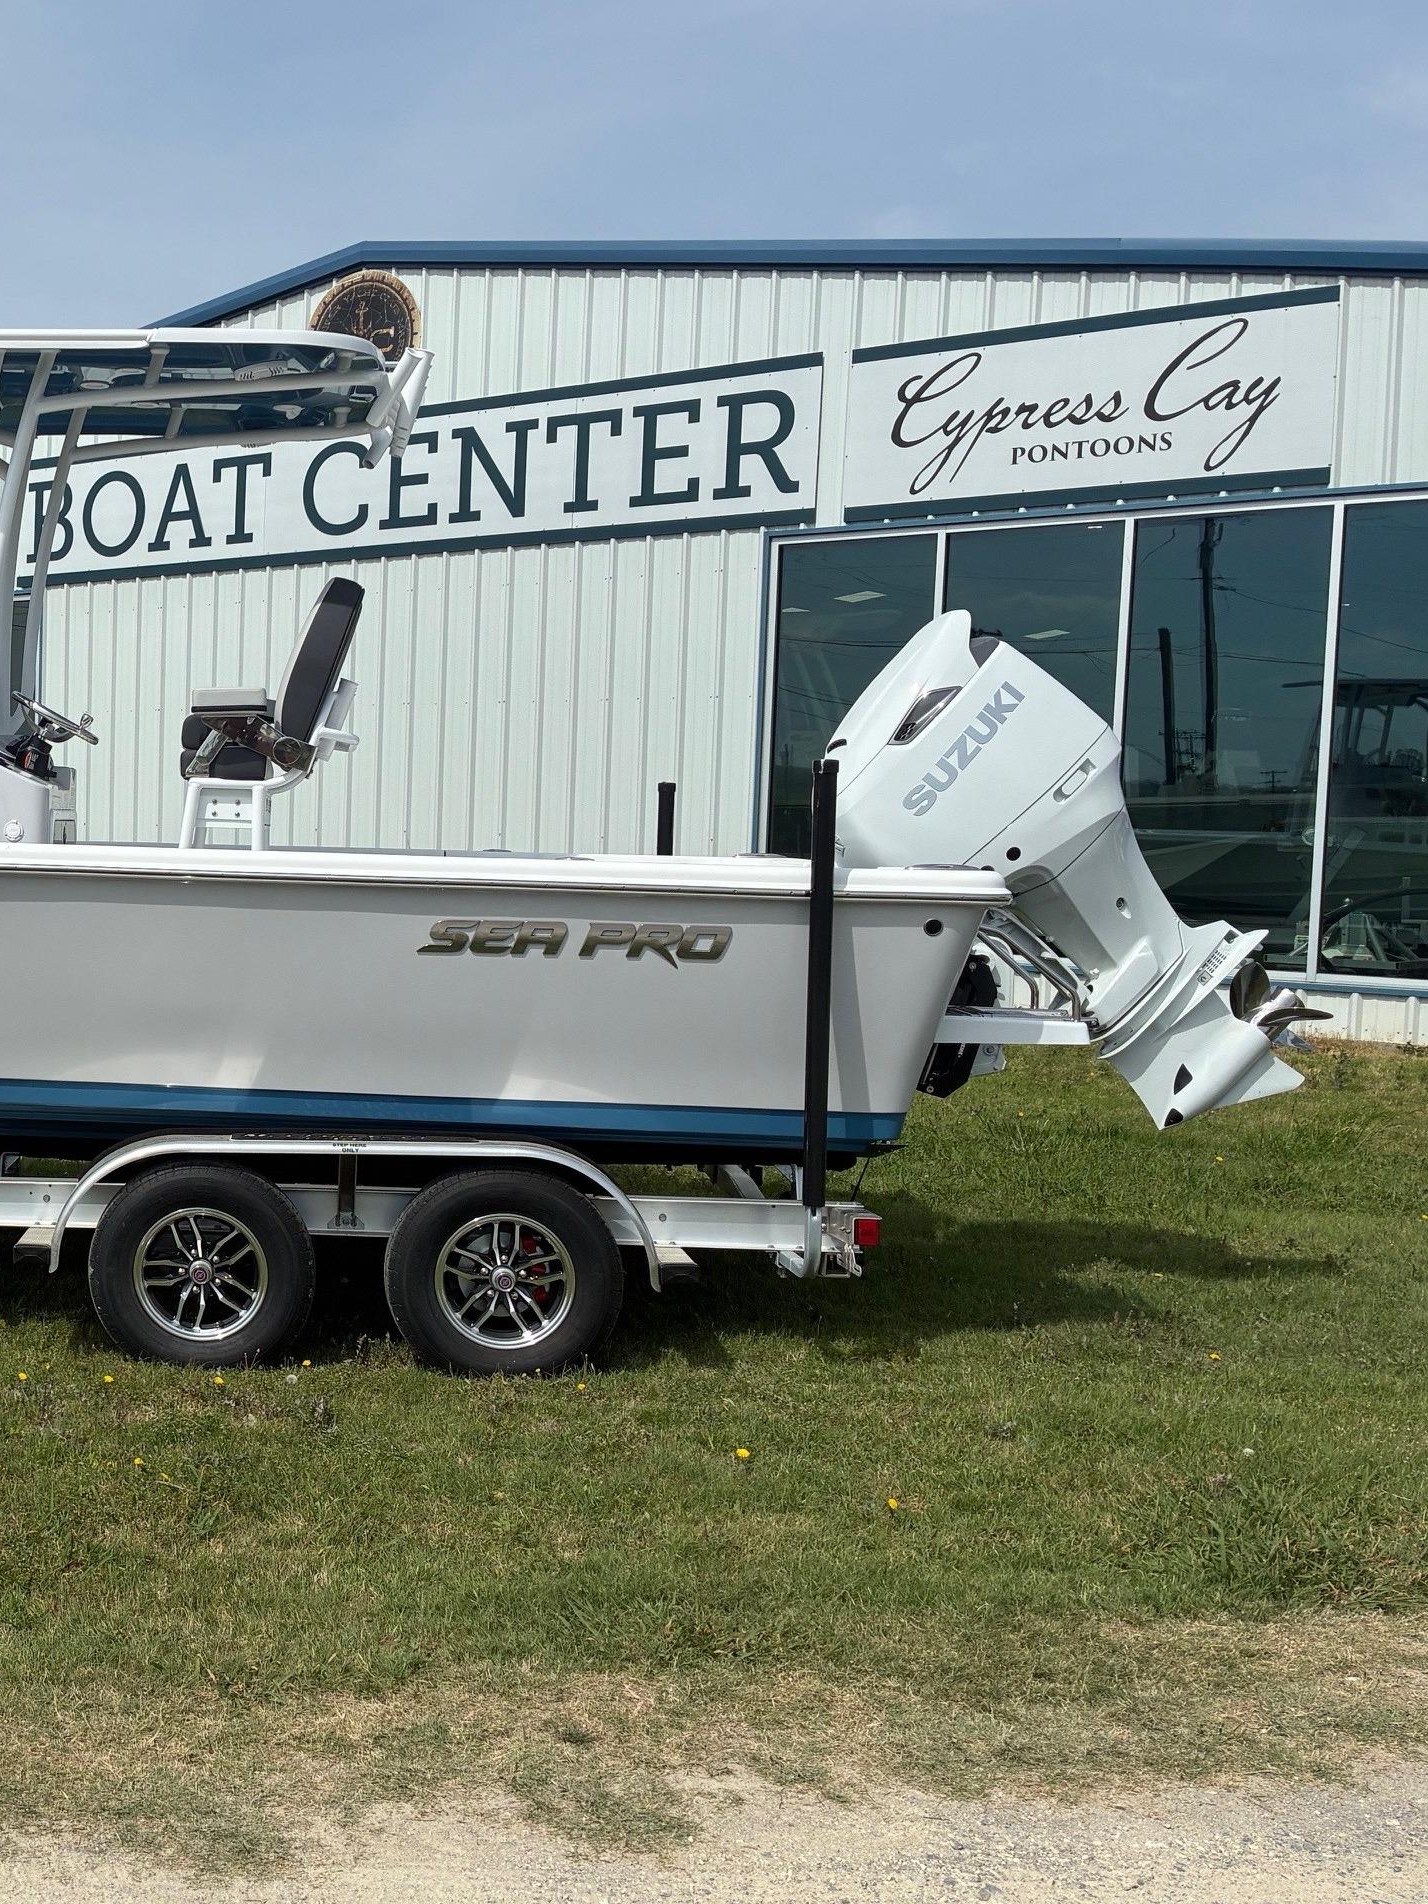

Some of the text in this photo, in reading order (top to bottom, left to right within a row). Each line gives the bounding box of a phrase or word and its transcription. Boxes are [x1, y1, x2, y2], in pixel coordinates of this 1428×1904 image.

[890, 318, 1282, 495] Cypress Cay
[1011, 431, 1173, 466] PONTOONS
[26, 389, 800, 564] BOAT CENTER
[902, 680, 1026, 817] SUZUKI
[416, 919, 734, 970] SEA PRO
